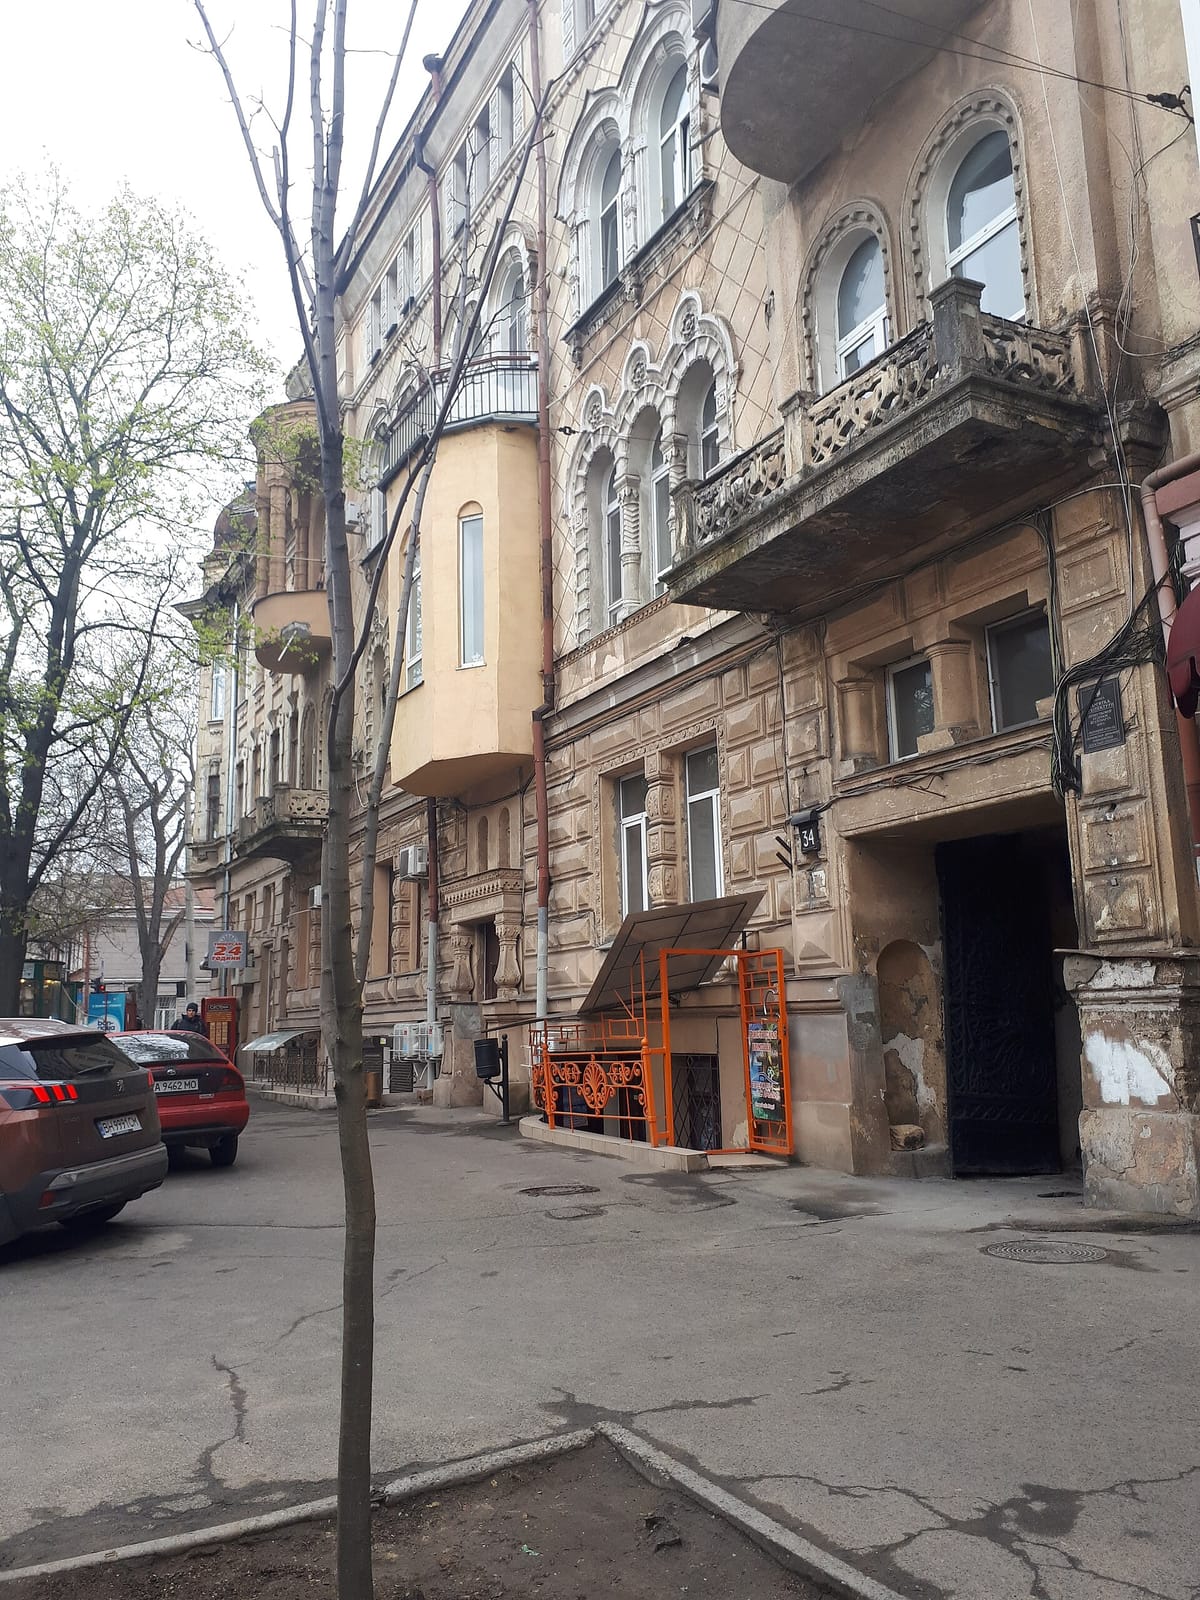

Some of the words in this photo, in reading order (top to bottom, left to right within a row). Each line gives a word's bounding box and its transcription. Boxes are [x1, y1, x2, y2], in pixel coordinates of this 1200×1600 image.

[801, 828, 816, 848] 34
[213, 945, 242, 956] 24
[162, 1081, 182, 1091] 9462
[184, 1080, 197, 1089] MO
